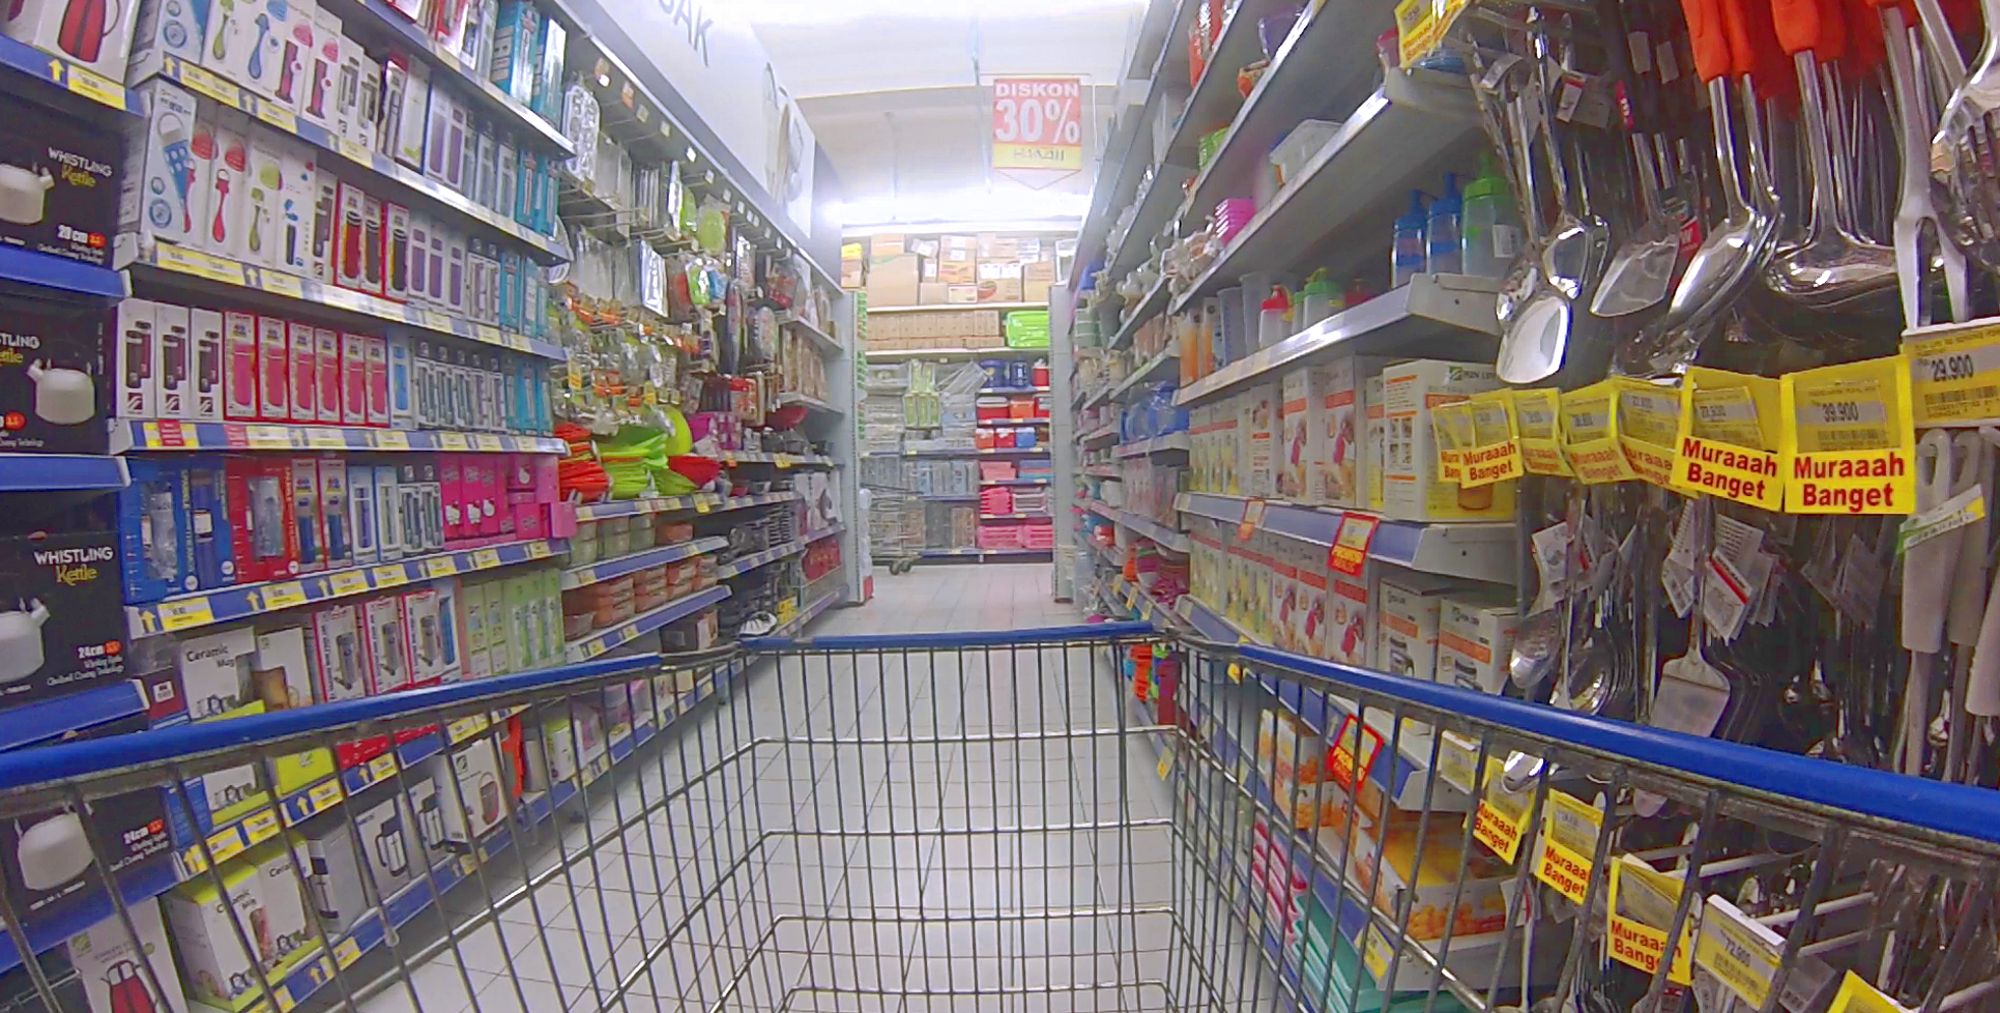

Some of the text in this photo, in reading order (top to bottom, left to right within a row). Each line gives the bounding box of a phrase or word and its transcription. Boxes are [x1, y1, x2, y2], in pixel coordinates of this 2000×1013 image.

[995, 83, 1079, 98] DISKON
[994, 98, 1080, 144] 30%
[47, 146, 113, 178] WHISTLING
[1463, 440, 1517, 466] Muraaah
[1682, 437, 1777, 478] Muraaah
[1793, 452, 1905, 480] Muraaah
[1469, 459, 1513, 481] Banget
[1687, 463, 1766, 501] Banget
[1802, 484, 1895, 512] Banget
[34, 547, 114, 566] WHISTLING
[56, 564, 98, 586] Kettle
[186, 644, 229, 662] Ceramic
[1544, 863, 1586, 898] Banget
